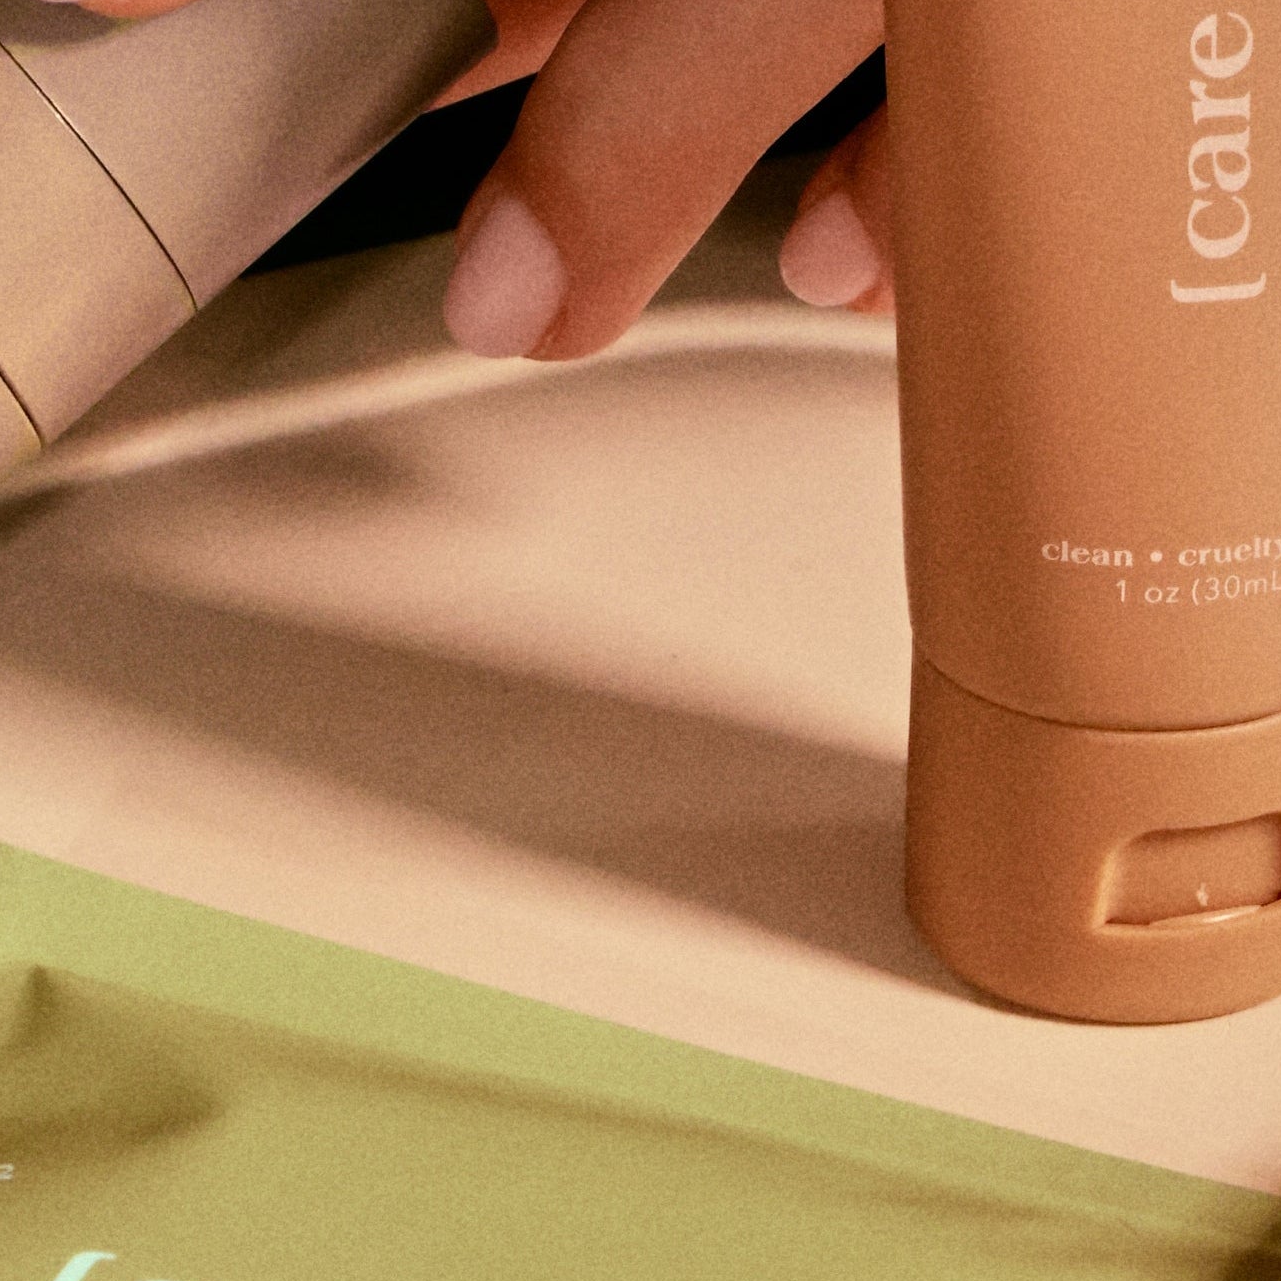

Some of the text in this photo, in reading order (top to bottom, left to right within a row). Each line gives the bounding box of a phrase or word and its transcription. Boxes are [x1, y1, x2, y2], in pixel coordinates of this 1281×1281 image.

[1041, 540, 1135, 568] clean
[1115, 578, 1128, 604] 1
[1143, 585, 1180, 606] oz
